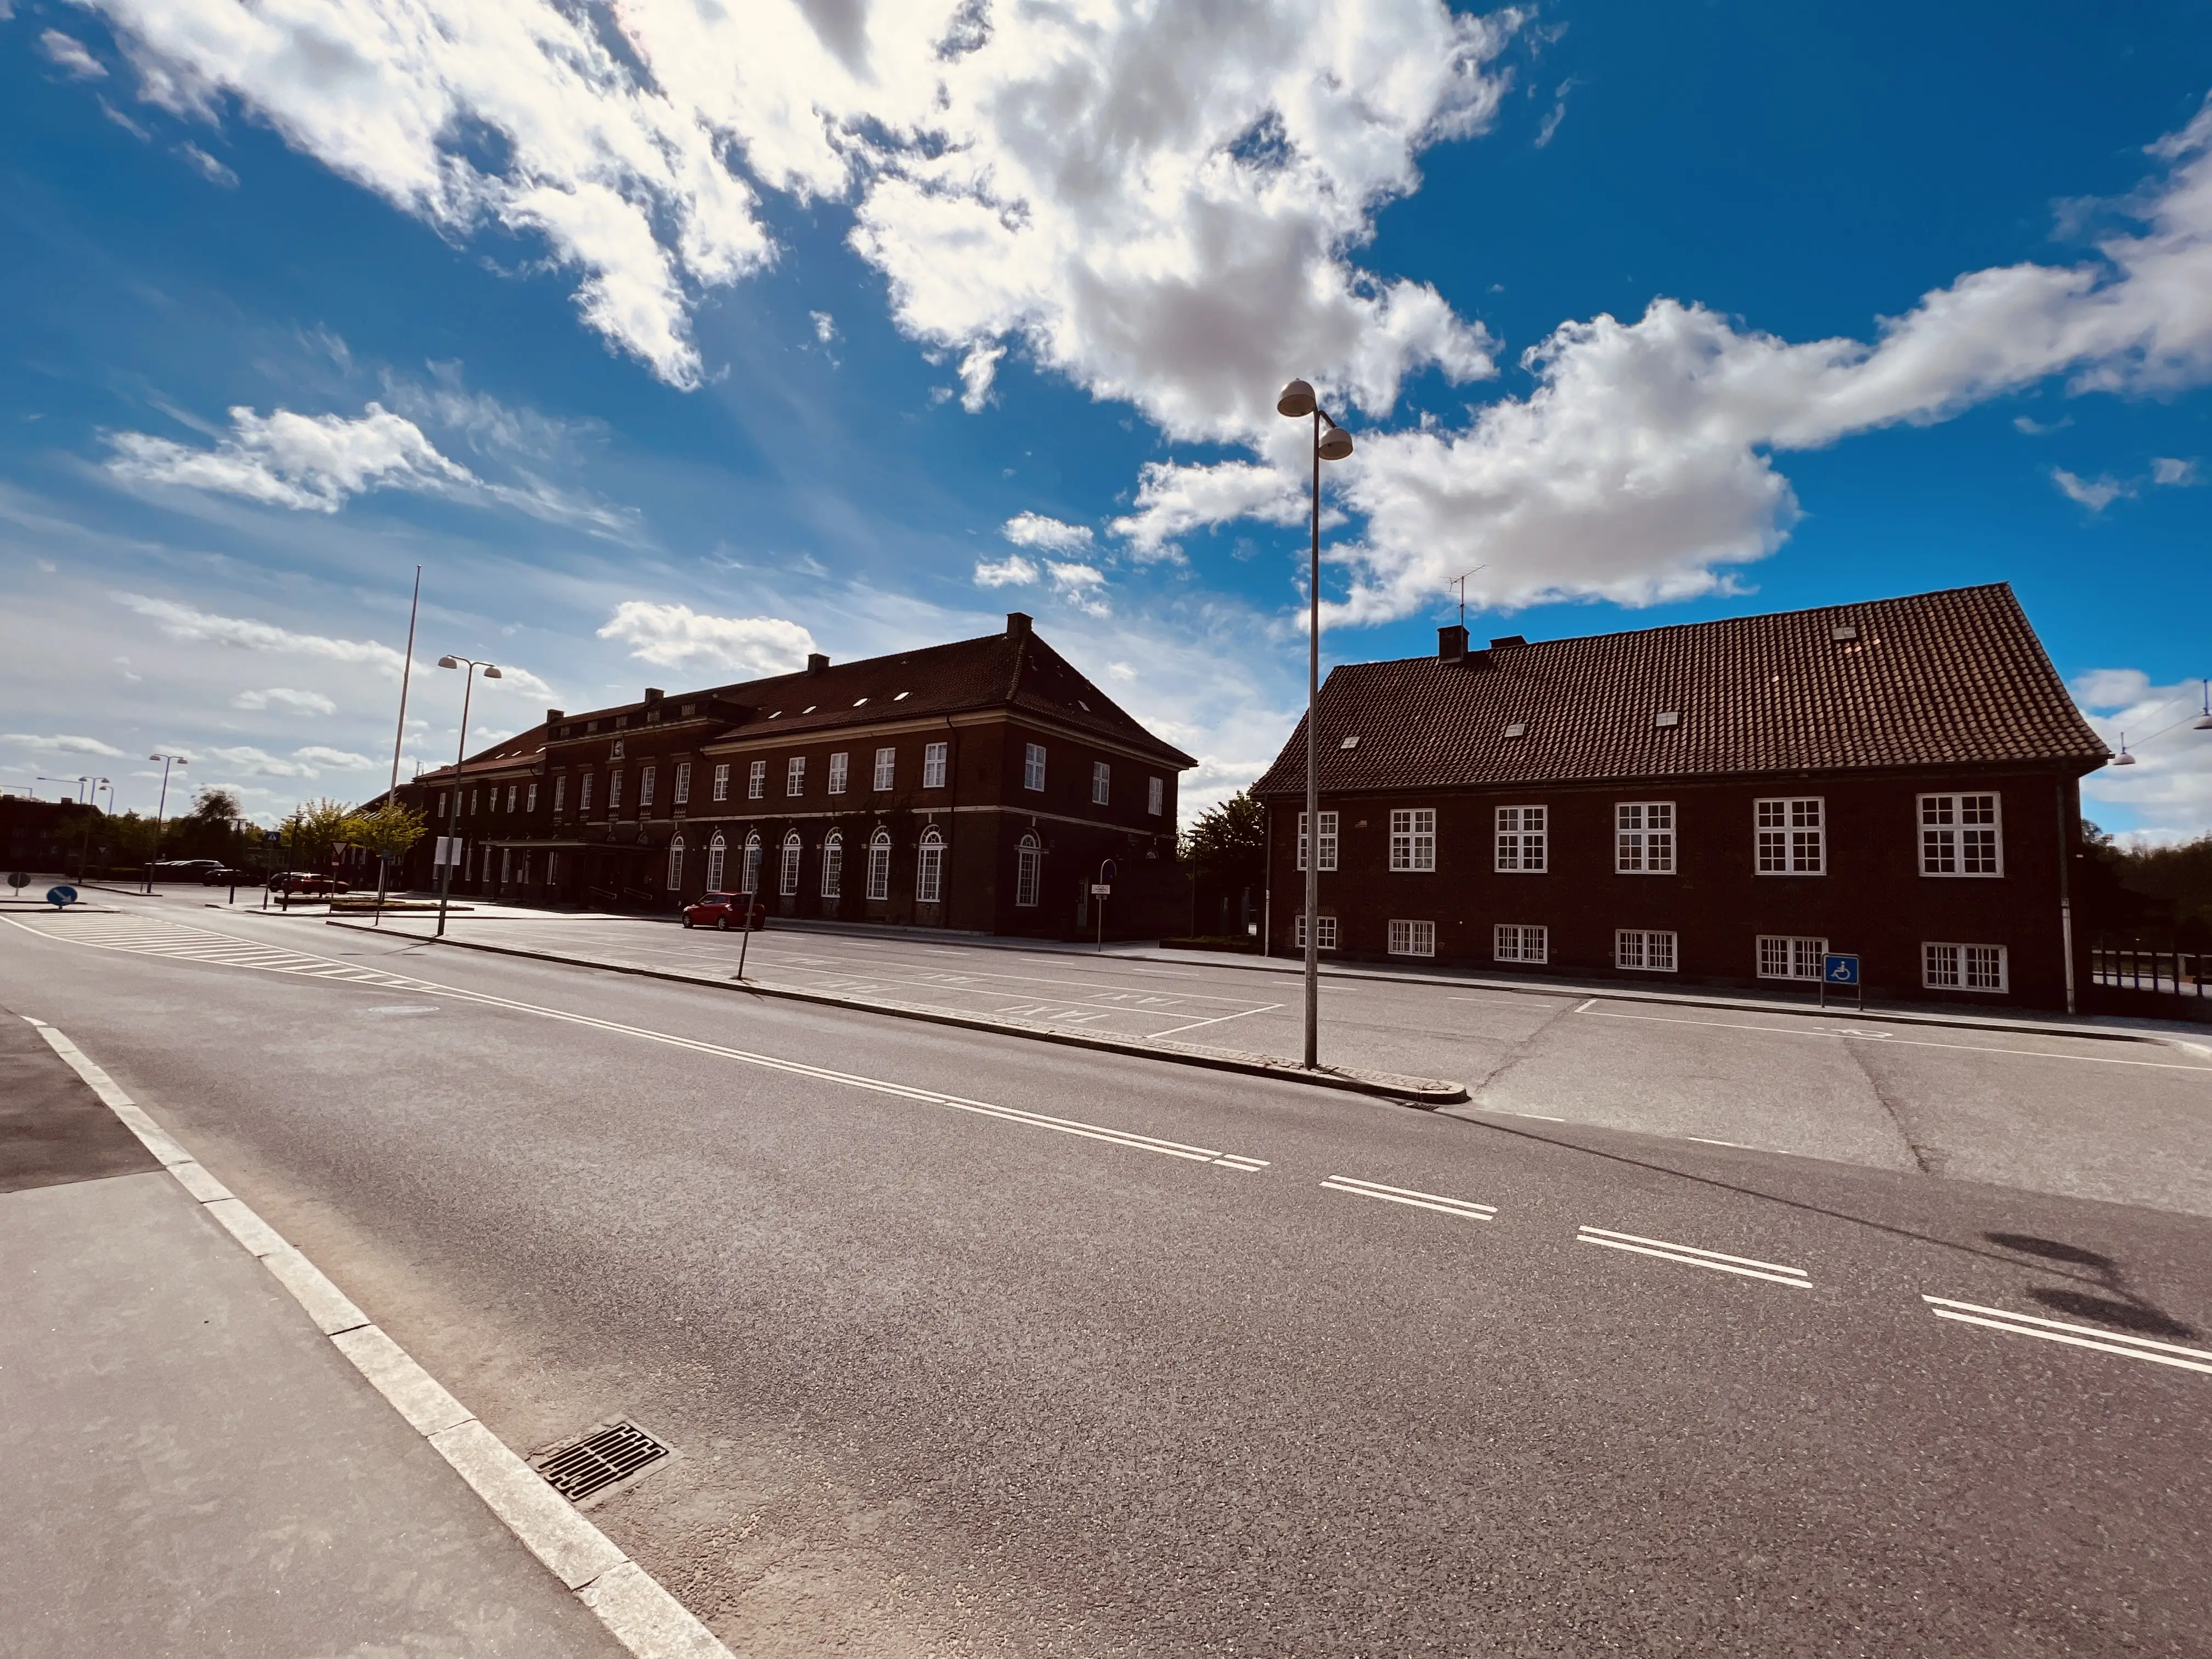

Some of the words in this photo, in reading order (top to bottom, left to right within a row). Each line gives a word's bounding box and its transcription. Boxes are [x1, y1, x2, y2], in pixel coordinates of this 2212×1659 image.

[907, 973, 990, 984] TAXI
[806, 980, 900, 993] TAXI
[1083, 992, 1187, 1006] TAXI
[994, 1005, 1111, 1023] TAXI
